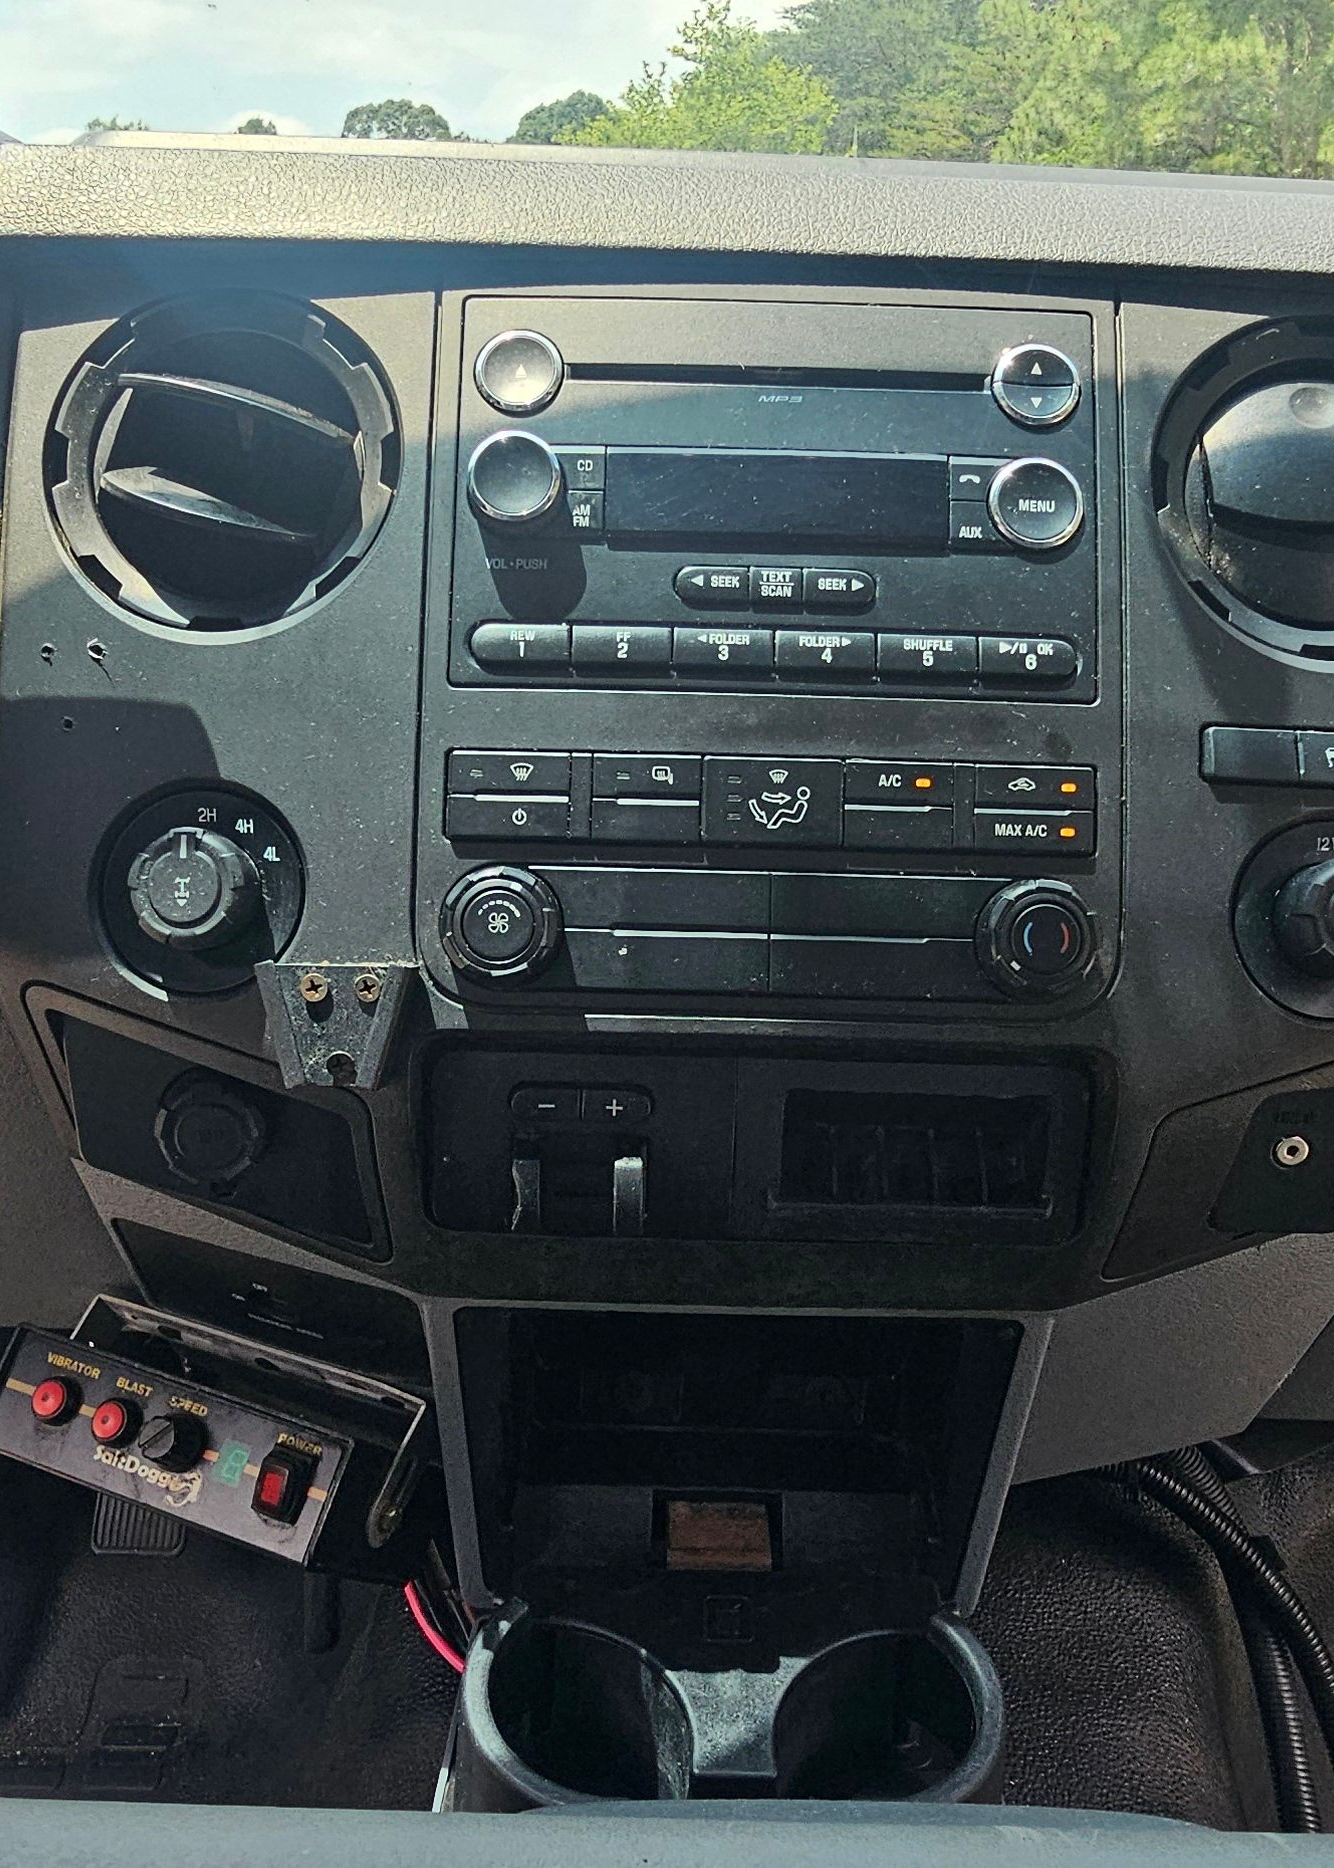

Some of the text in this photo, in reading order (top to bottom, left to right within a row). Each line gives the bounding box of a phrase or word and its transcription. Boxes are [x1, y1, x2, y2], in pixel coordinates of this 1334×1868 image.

[758, 395, 803, 403] MP3
[577, 460, 593, 472] CD
[572, 504, 591, 516] AM
[1018, 499, 1055, 513] MENU
[573, 516, 590, 528] FM
[959, 526, 982, 539] AUX
[515, 558, 548, 570] PUSH
[710, 576, 740, 588] SEEK
[761, 571, 792, 583] TEXT
[760, 585, 792, 597] SCAN
[818, 578, 847, 591] SEEK
[510, 630, 535, 641] REW
[616, 632, 631, 642] FF
[708, 634, 750, 646] FOLDER
[799, 636, 840, 648] FOLDER
[518, 642, 525, 657] 1
[617, 642, 628, 658] 2
[903, 638, 953, 651] SHUFFLE
[1037, 643, 1054, 656] OK
[718, 645, 729, 660] 3
[821, 648, 832, 663] 4
[922, 651, 934, 667] 5
[1025, 654, 1037, 670] 6
[878, 774, 901, 787] A/C
[197, 807, 217, 823] 2H
[235, 818, 254, 834] 4H
[995, 824, 1047, 837] MAX A/C
[263, 846, 281, 862] 4L
[47, 1352, 101, 1380] VIBRATOR
[116, 1376, 154, 1398] BLAST
[169, 1395, 208, 1417] SPEED
[276, 1432, 323, 1456] POWER
